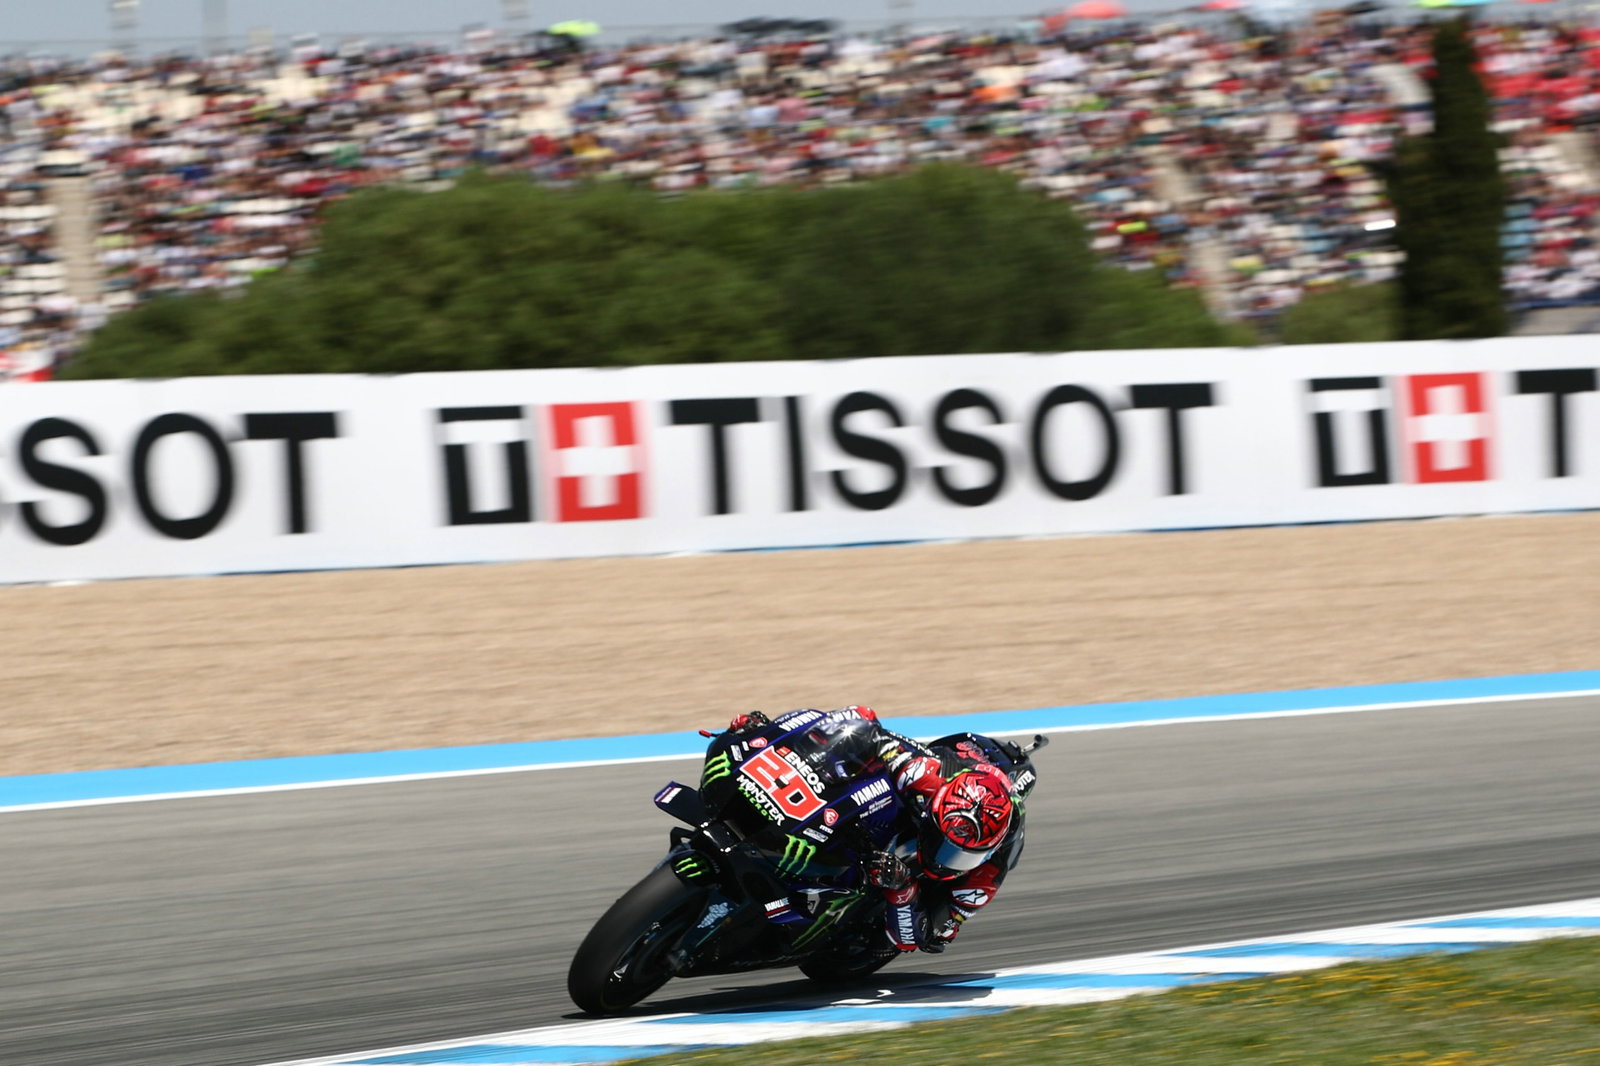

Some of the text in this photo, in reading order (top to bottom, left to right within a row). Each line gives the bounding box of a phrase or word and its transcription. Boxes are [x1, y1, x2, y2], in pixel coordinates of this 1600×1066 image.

[664, 381, 1217, 517] TISSOT
[0, 411, 344, 547] SOT
[778, 709, 823, 732] YAMAHA
[739, 745, 828, 821] 20
[783, 751, 826, 795] ENEOS
[850, 778, 891, 807] YAMAHA
[736, 774, 786, 826] MONSTER
[737, 785, 775, 822] ENERGY
[897, 904, 916, 945] YAMAHA
